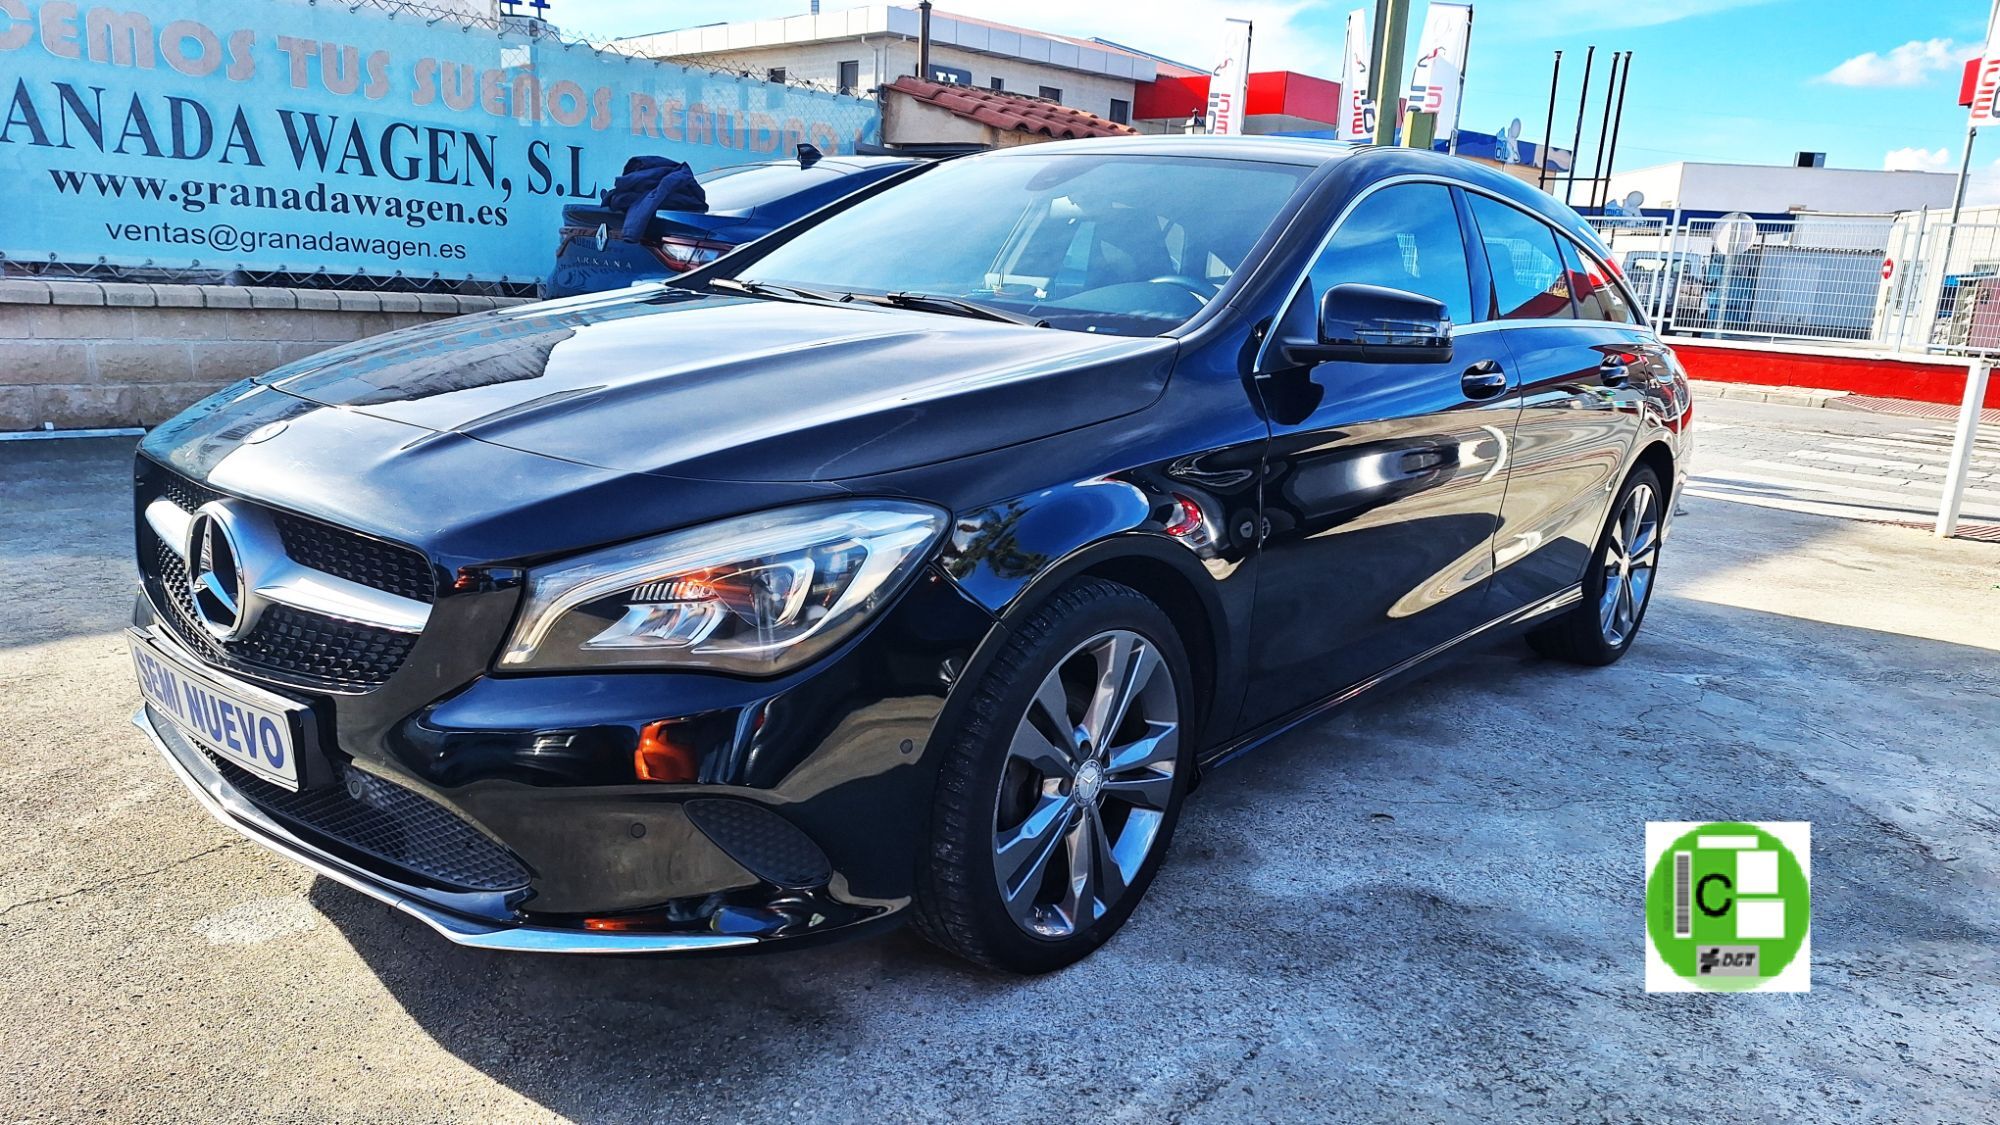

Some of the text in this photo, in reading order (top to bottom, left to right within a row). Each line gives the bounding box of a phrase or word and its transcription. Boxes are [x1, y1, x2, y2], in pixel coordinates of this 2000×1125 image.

[275, 35, 391, 100] TUS
[412, 57, 613, 131] SUEÑOS
[0, 76, 607, 203] ANADA WAGEN, S.L.
[49, 168, 509, 229] www.granadawagen.es
[105, 221, 467, 261] ventas@granadawagen.es
[576, 255, 632, 270] ARKANA
[134, 645, 285, 770] SEMI NUEVO
